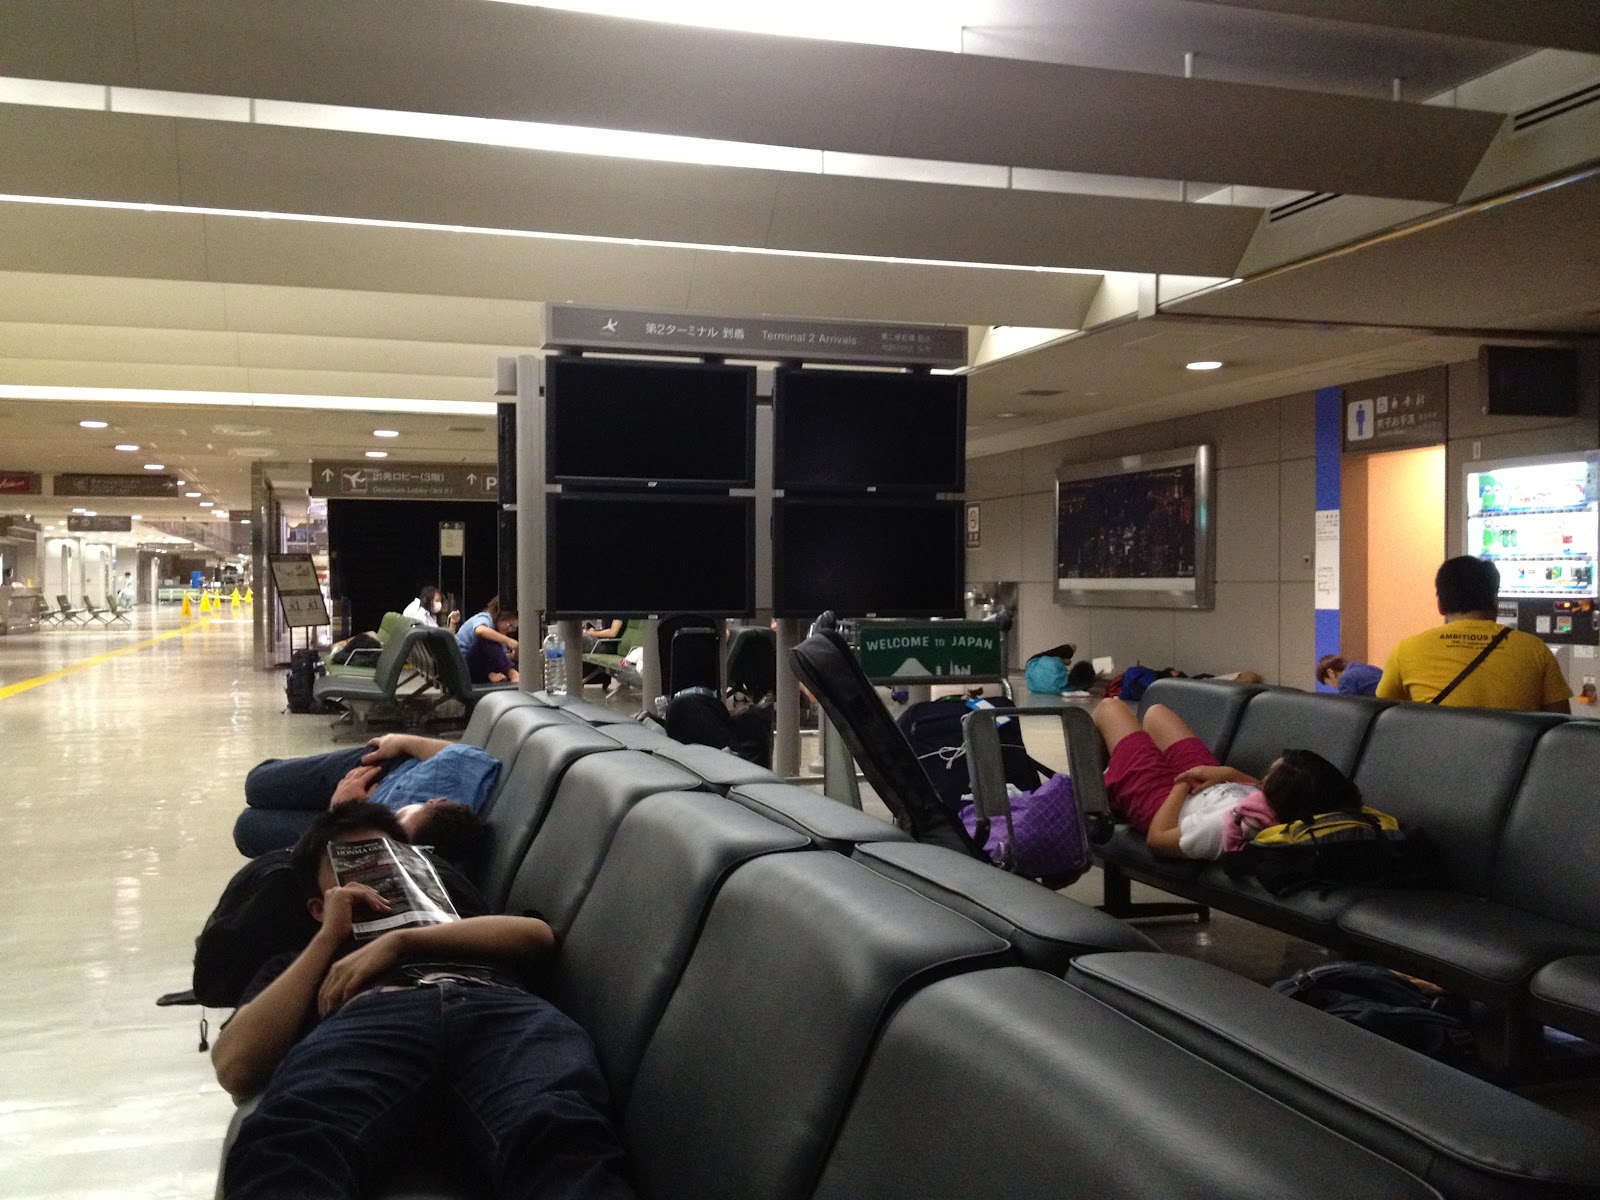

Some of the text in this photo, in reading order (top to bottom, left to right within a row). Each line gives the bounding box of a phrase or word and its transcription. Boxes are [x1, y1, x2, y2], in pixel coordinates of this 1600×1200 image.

[645, 322, 718, 338] 第2ターミナル
[761, 329, 857, 345] Terminal 2 Arrivals
[407, 486, 428, 495] Lobby
[866, 636, 930, 651] WELCOME
[952, 636, 993, 650] JAPAN
[1439, 633, 1489, 641] AMBITIOUS
